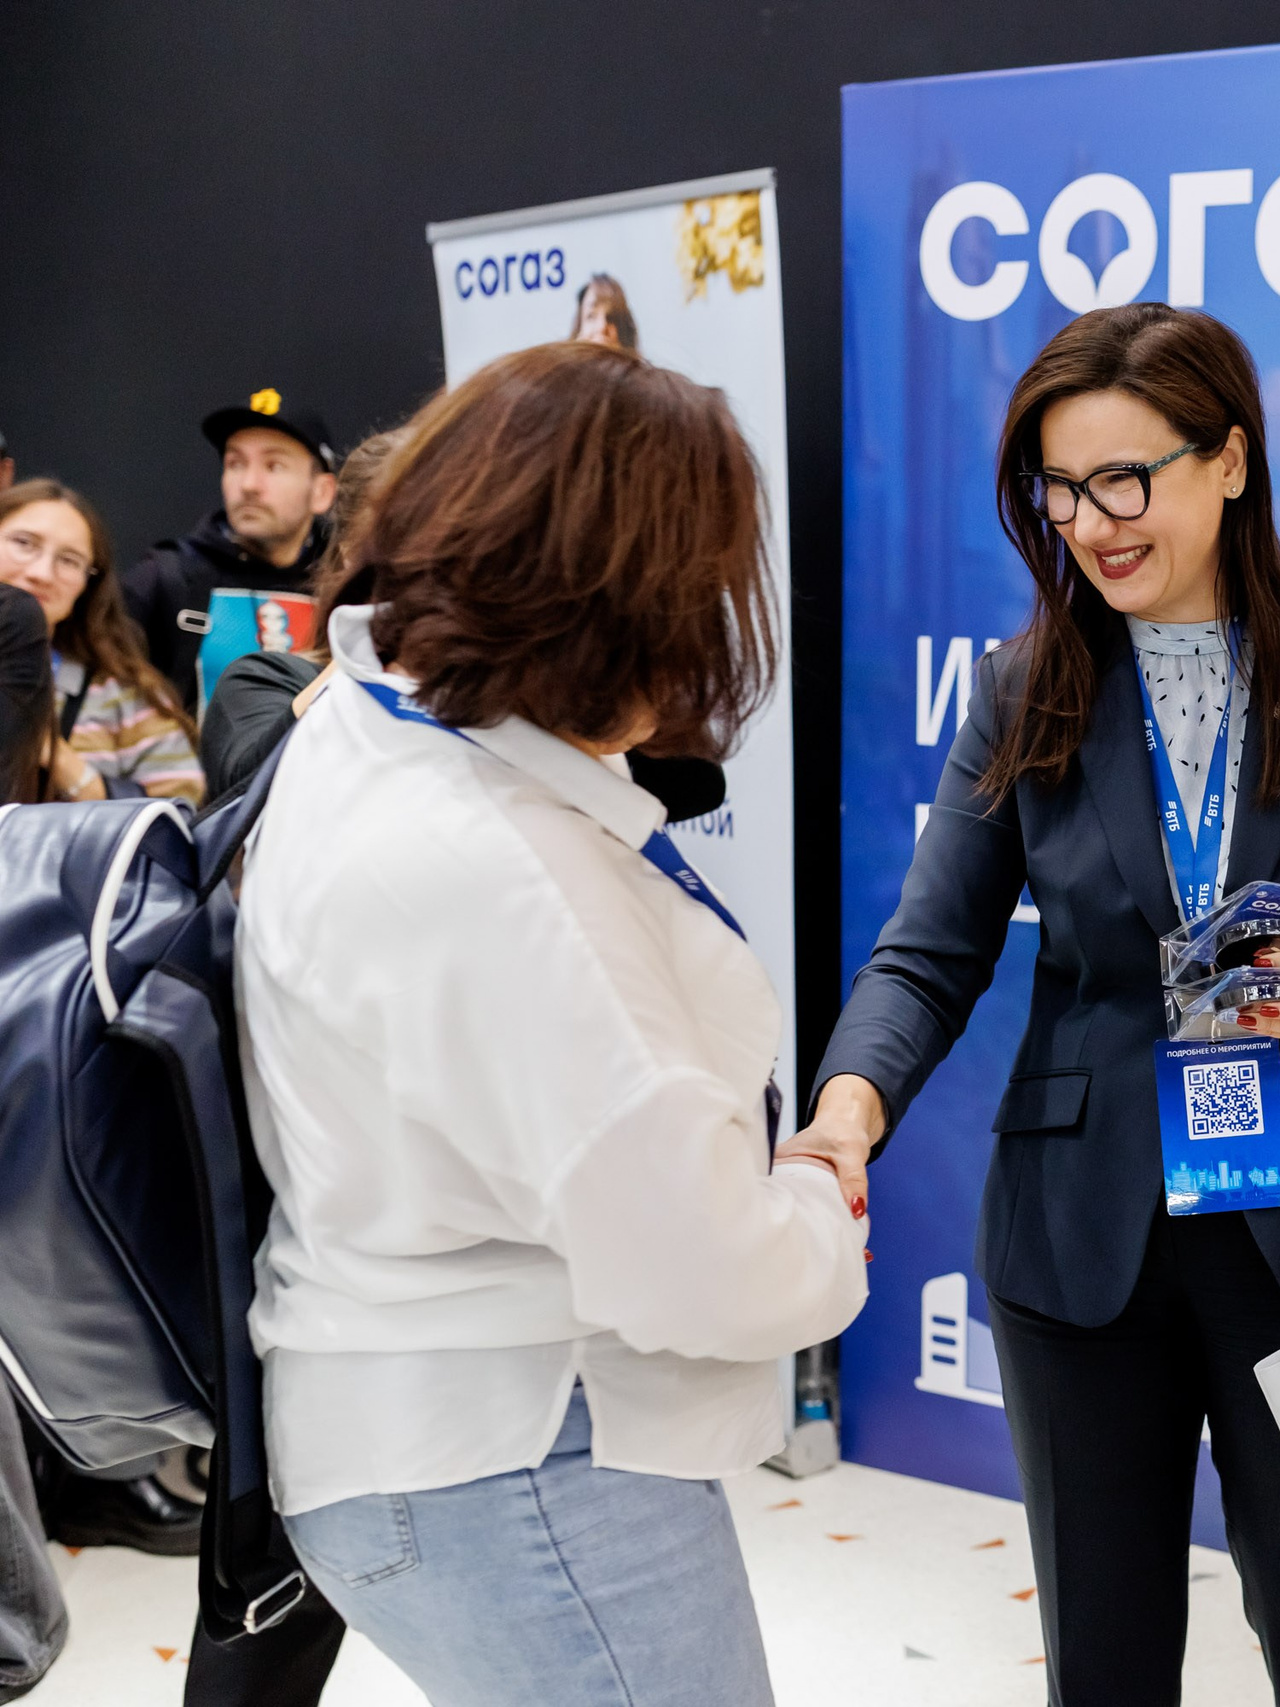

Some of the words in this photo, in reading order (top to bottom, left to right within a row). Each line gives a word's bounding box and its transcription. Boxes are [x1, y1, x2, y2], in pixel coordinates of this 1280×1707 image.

[1207, 794, 1220, 817] ВТБ
[1165, 810, 1180, 832] ВТБ
[1197, 883, 1210, 906] ВТБ
[1166, 1047, 1210, 1058] ПОДРОБНЕЕ
[1218, 1042, 1272, 1053] МЕРОПРИЯТИИ
